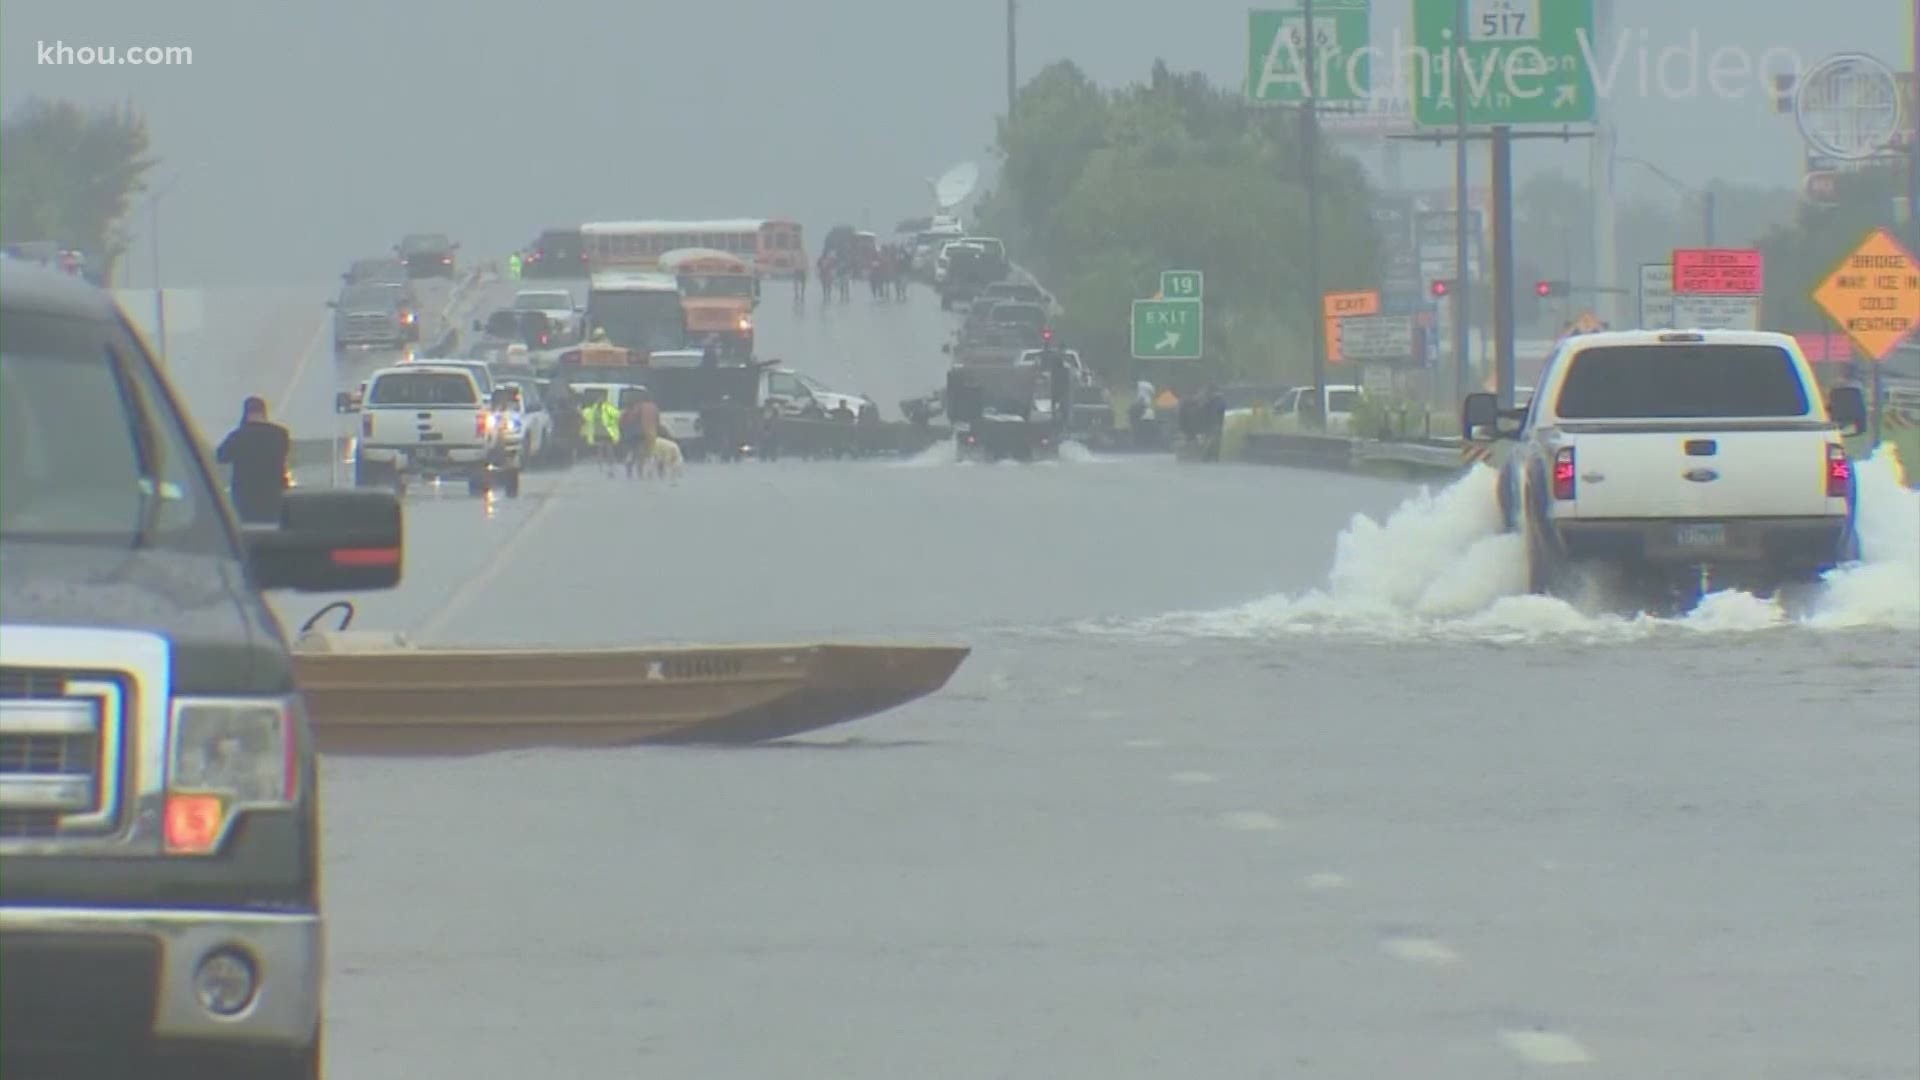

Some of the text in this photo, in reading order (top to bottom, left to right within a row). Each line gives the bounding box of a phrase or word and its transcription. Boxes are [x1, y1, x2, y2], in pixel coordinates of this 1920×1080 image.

[1482, 13, 1526, 36] 517
[1291, 27, 1329, 46] 66
[1432, 54, 1577, 74] Dinson
[1435, 90, 1512, 111] Avin
[1851, 254, 1905, 268] BRIDGE
[1683, 268, 1757, 279] ROAD WORK
[1171, 277, 1193, 293] 19
[1836, 275, 1918, 290] MAY ICE IN
[1859, 297, 1898, 310] COLD
[1145, 310, 1187, 324] EXIT
[1845, 317, 1911, 332] WEATHER
